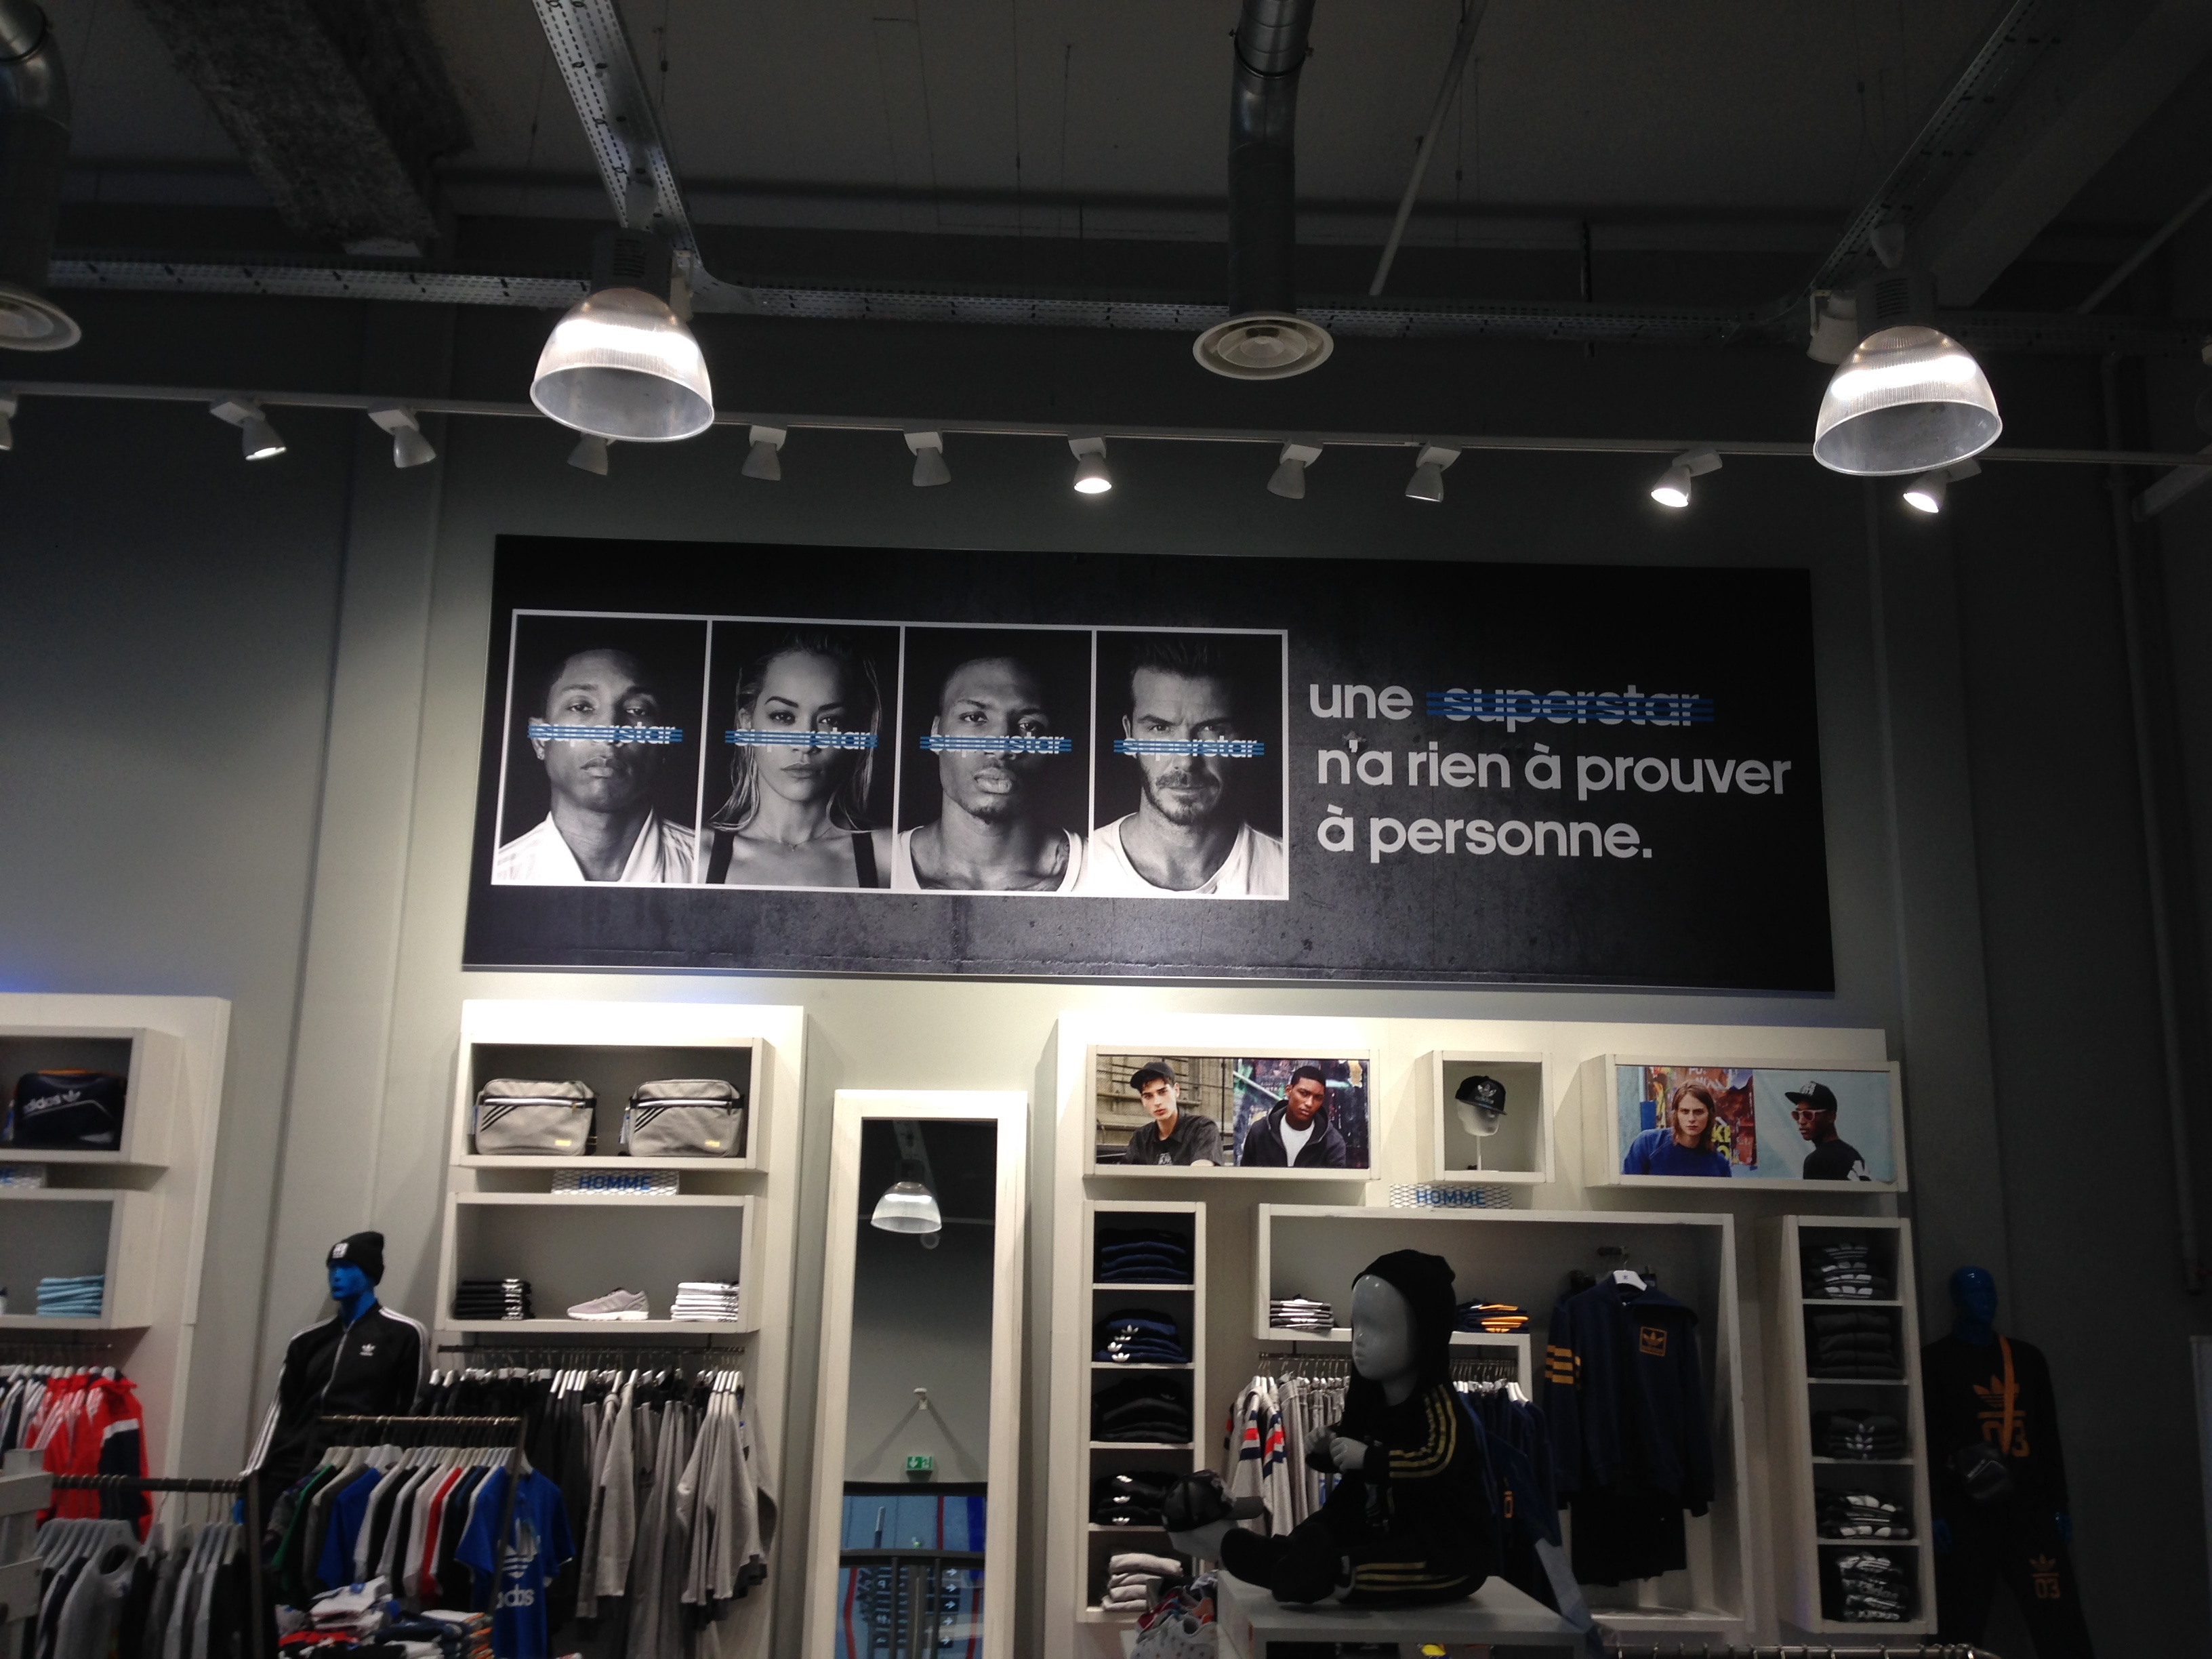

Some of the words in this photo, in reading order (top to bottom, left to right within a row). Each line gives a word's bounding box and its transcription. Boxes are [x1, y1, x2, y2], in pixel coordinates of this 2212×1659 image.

[1309, 684, 1414, 720] une
[1443, 684, 1700, 733] superstar
[1318, 739, 1393, 785] n'a
[1408, 741, 1511, 787] rien
[1525, 742, 1561, 790] à
[1577, 756, 1792, 801] prouver
[1317, 804, 1354, 853] à
[1370, 817, 1653, 864] personne.
[579, 1176, 651, 1191] HOMME
[1416, 1189, 1486, 1205] HOMME
